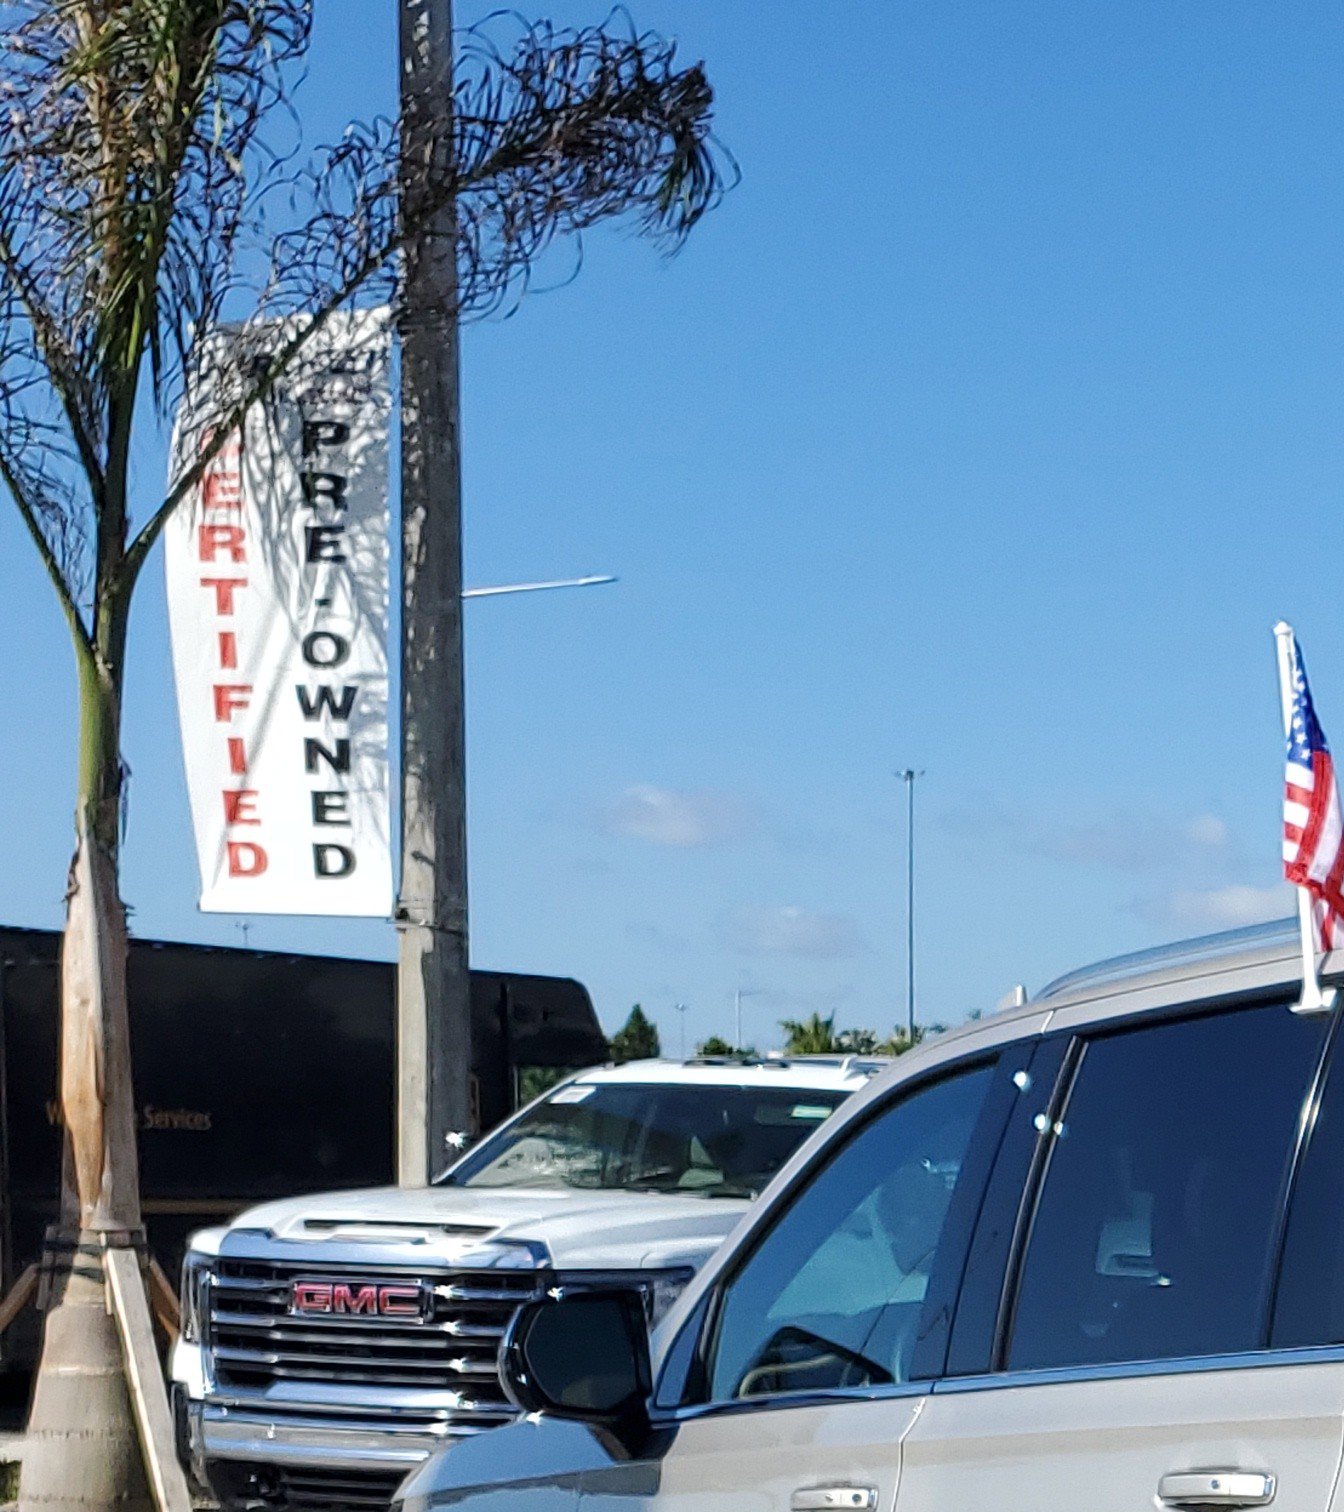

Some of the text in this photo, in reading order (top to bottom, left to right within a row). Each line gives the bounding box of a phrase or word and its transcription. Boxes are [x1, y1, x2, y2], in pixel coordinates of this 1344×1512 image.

[296, 421, 358, 879] PRE-OWNED
[143, 1104, 212, 1130] Services
[295, 1282, 420, 1315] GMC
